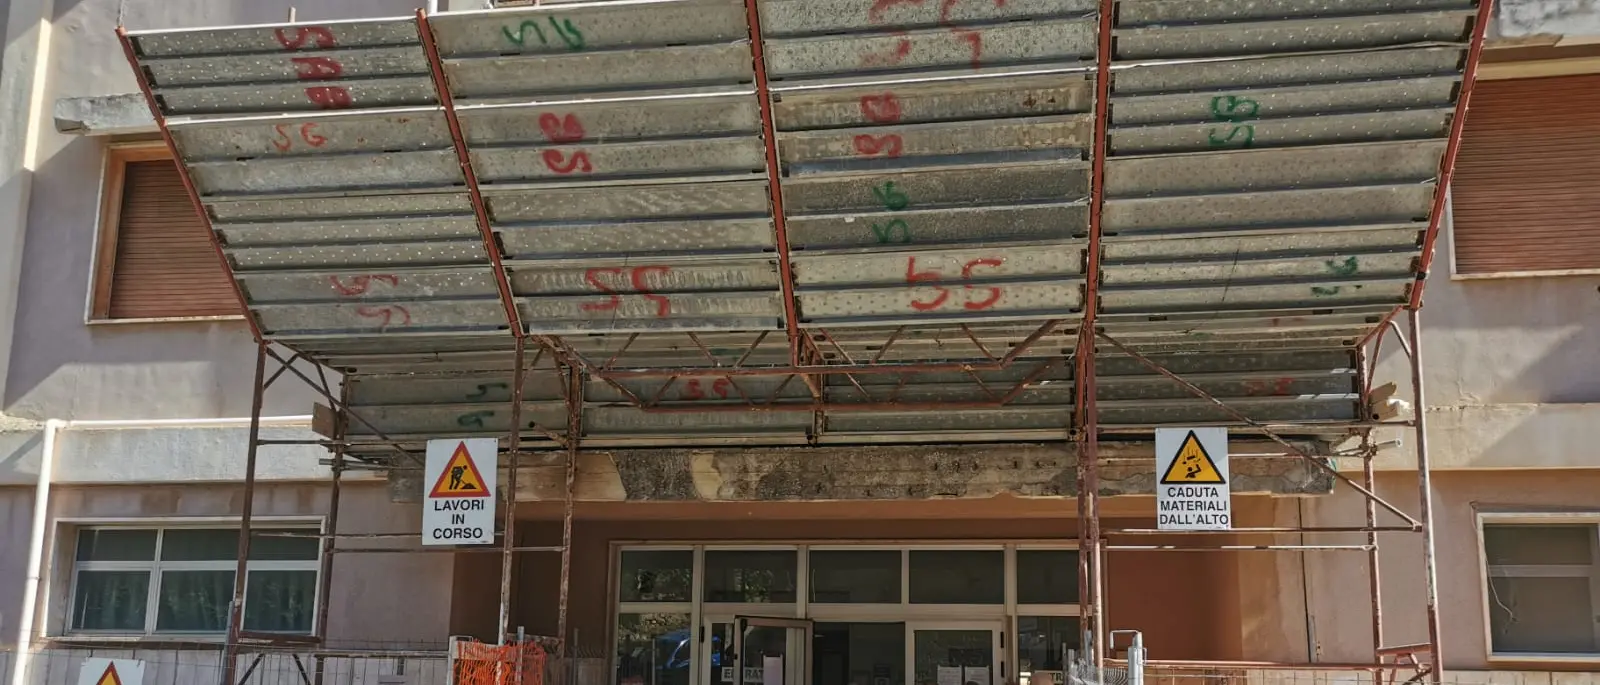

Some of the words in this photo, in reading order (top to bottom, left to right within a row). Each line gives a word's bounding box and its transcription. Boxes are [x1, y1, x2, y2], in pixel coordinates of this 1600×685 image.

[1167, 487, 1219, 498] CADUTA
[434, 499, 484, 511] LAVORI
[1160, 500, 1227, 511] MATERIALI
[451, 513, 465, 525] IN
[1160, 513, 1229, 525] DALL'ALTO
[432, 527, 483, 539] CORSO
